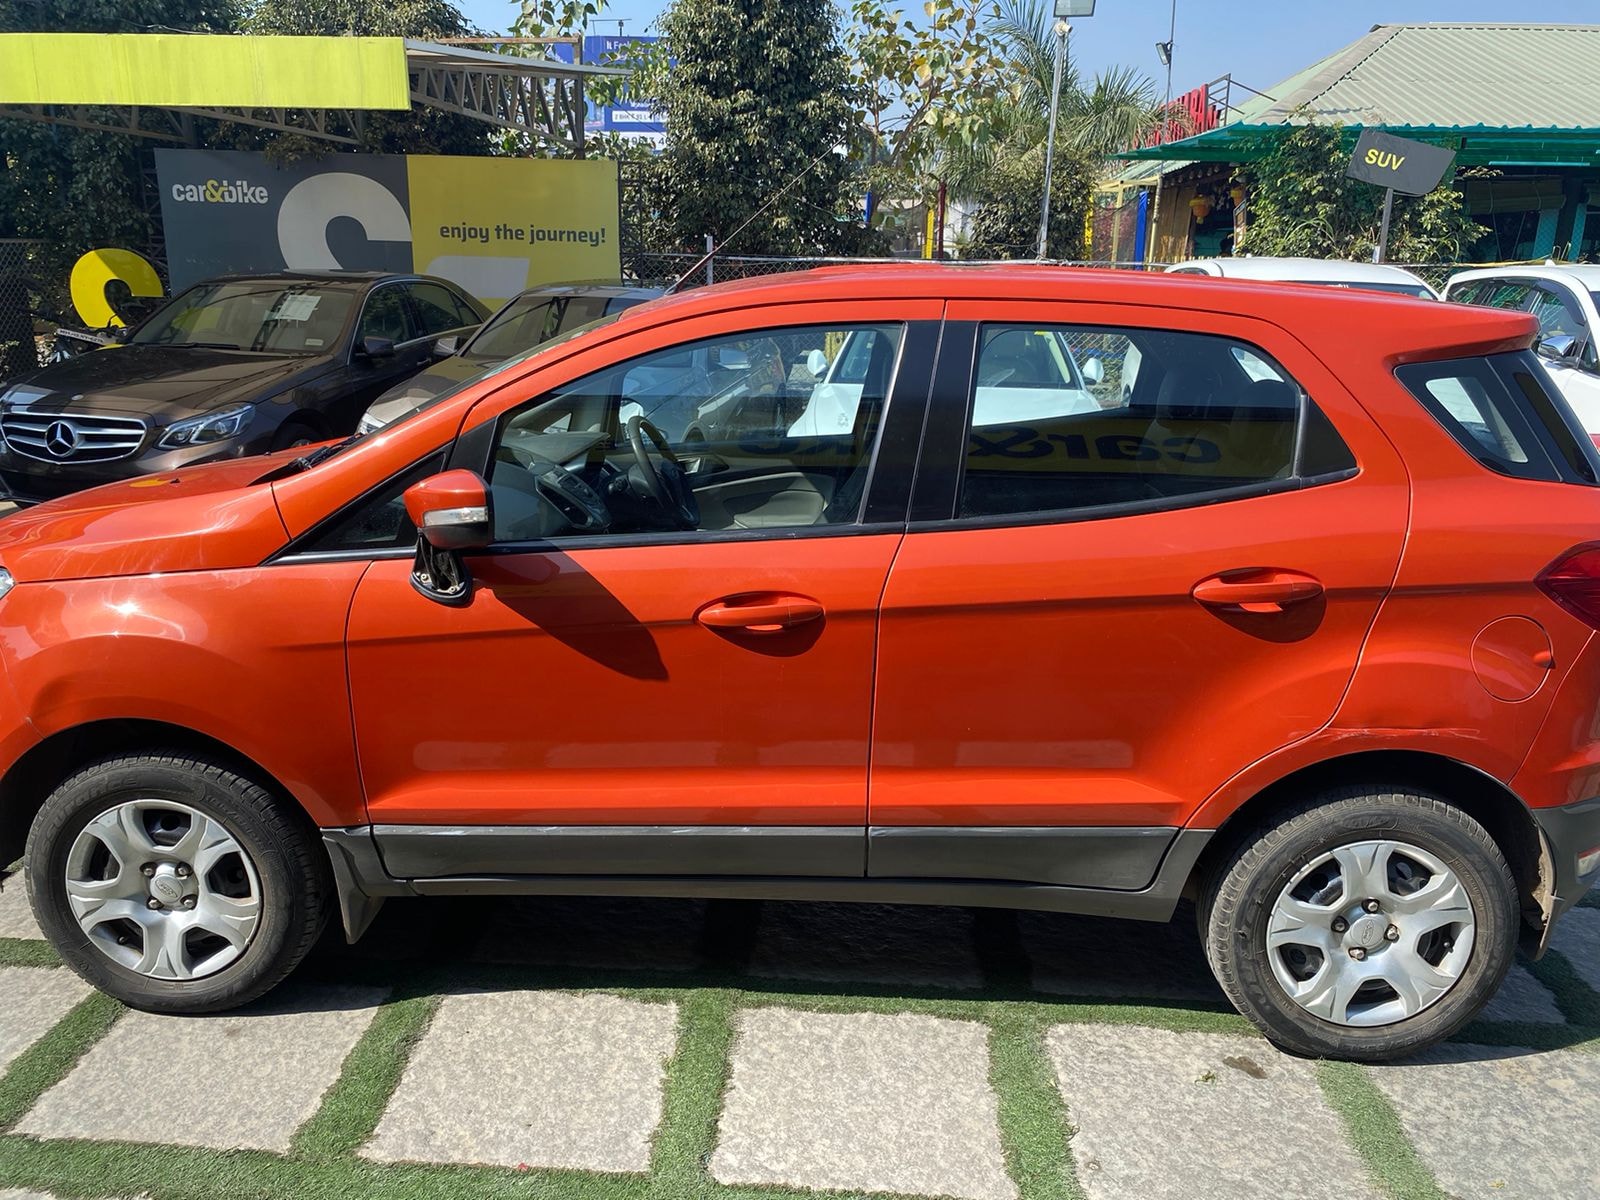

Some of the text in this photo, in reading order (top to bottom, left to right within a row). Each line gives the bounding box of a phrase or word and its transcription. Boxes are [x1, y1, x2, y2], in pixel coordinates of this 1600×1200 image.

[1364, 148, 1406, 171] SUV
[172, 179, 269, 204] car&bike
[439, 222, 606, 247] enjoy the journey!
